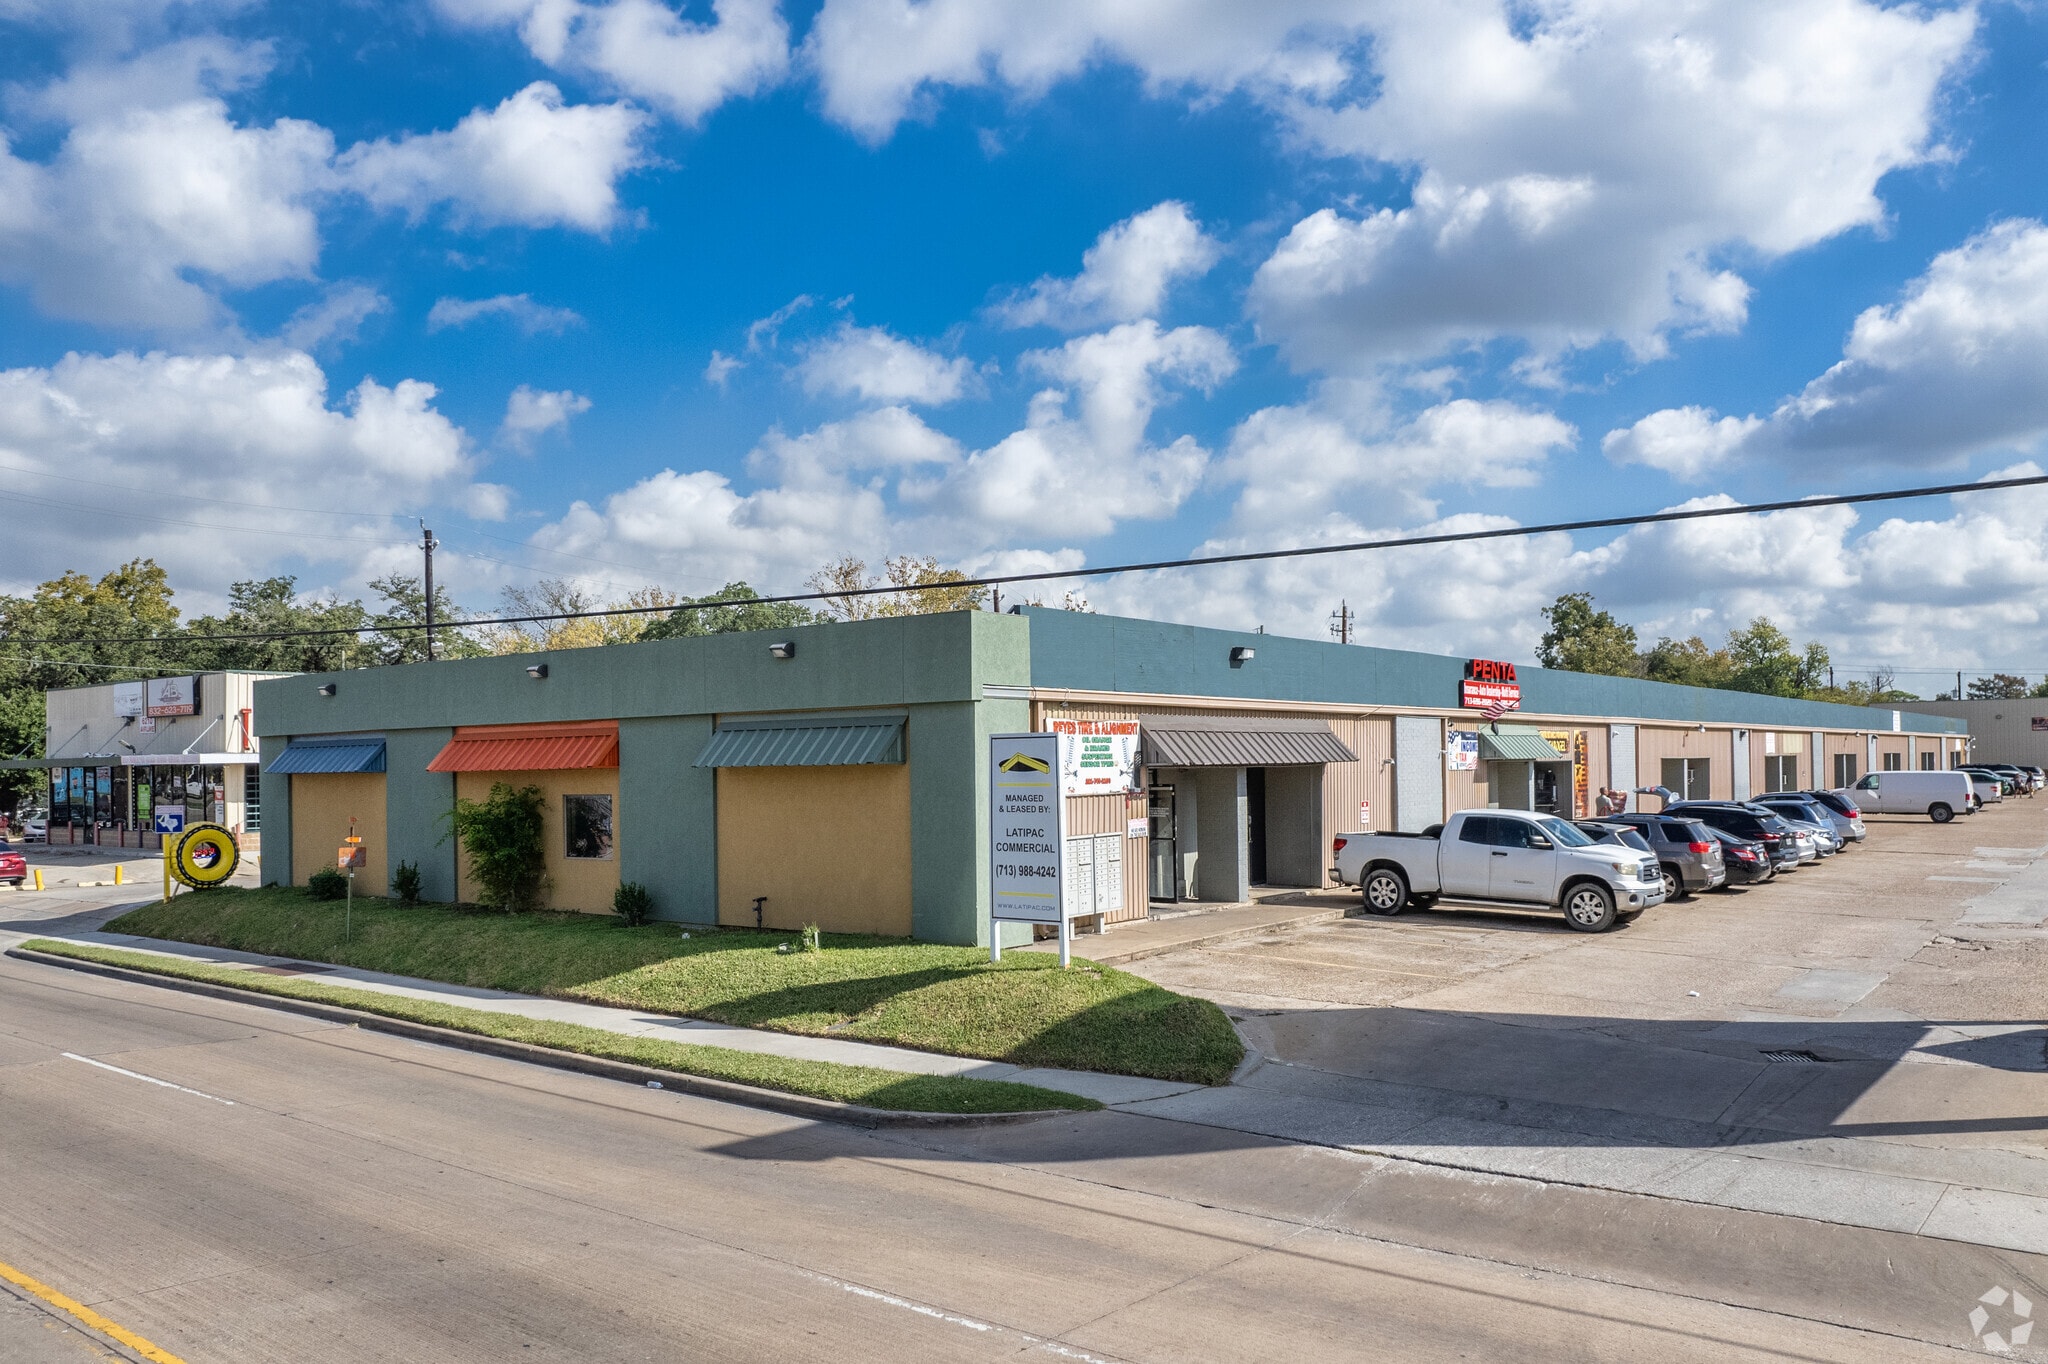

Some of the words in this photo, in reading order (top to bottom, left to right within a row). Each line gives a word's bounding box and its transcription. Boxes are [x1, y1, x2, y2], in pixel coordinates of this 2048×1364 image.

[1473, 658, 1517, 682] PENTA
[149, 705, 193, 715] 832-623-7119
[1053, 720, 1076, 735] REYES
[1077, 721, 1093, 735] TIRE
[1101, 722, 1139, 735] ALIGNMENT
[1005, 794, 1044, 802] MANAGED
[999, 805, 1004, 813] &
[1006, 805, 1037, 813] LEASED
[1038, 805, 1051, 813] BY:
[1006, 828, 1045, 838] LATIPAC
[995, 842, 1055, 853] COMMERCIAL
[995, 864, 1016, 879] (713)
[1018, 865, 1056, 878] 988-4242
[997, 903, 1056, 911] WWW.LATIPAC.COM
